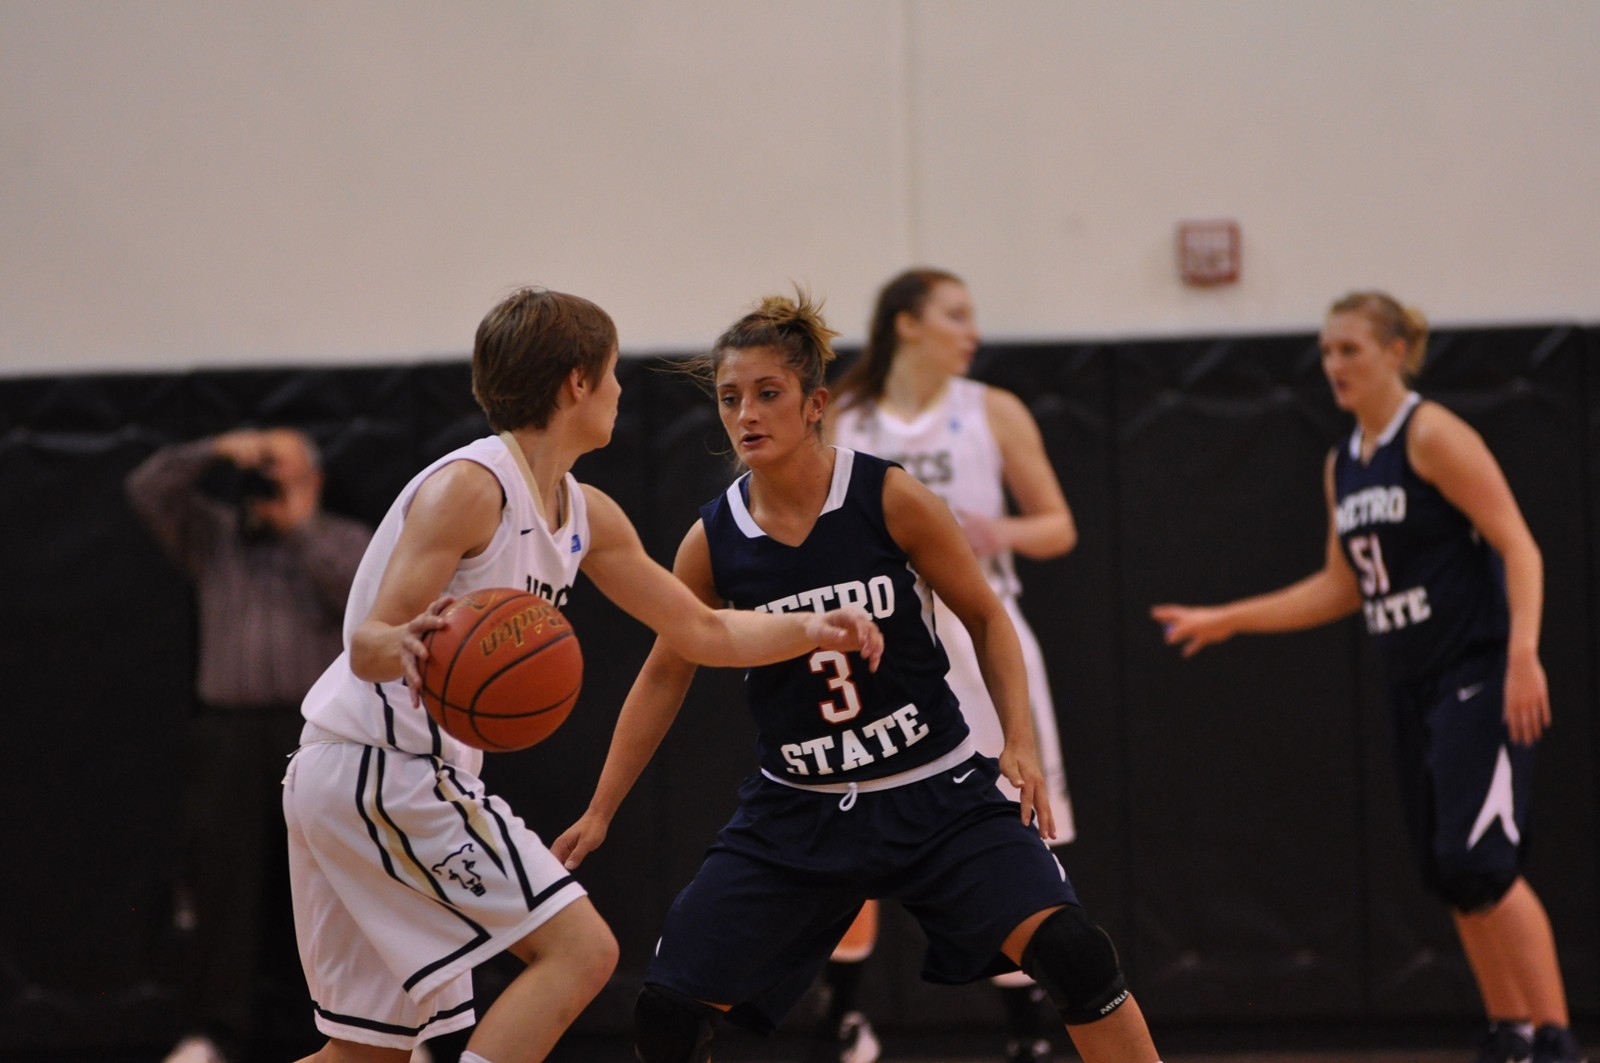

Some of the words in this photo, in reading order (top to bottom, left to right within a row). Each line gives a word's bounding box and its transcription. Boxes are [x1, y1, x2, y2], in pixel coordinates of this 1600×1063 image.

[1349, 533, 1390, 597] 51
[808, 649, 863, 725] 3
[780, 702, 930, 776] STATE
